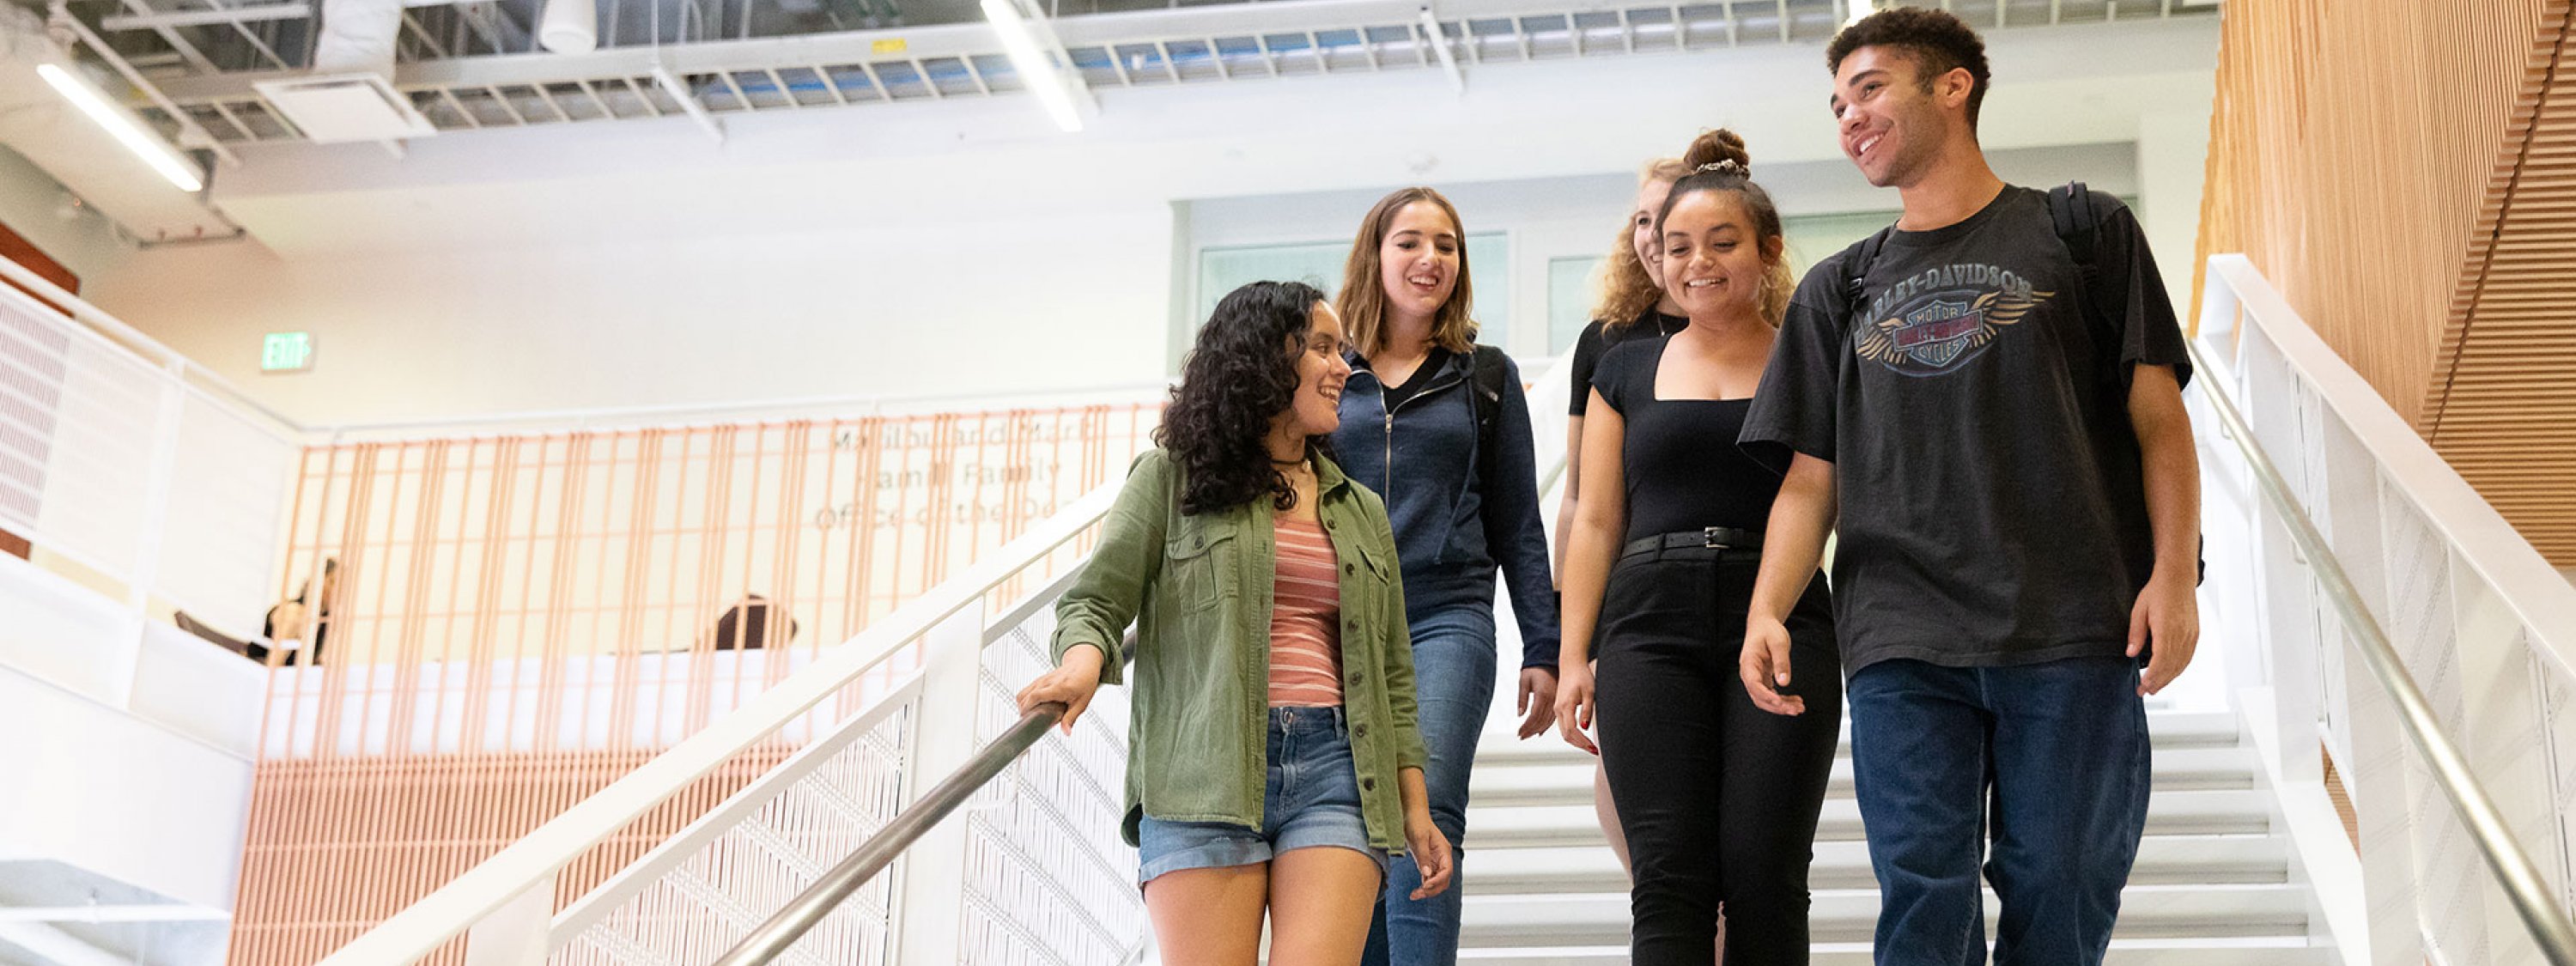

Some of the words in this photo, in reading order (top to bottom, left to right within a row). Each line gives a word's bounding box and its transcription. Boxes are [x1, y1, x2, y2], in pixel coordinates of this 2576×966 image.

[1916, 306, 1958, 325] MOTOR
[1917, 340, 1960, 362] CYCLES
[835, 422, 936, 450] Mailou
[956, 418, 1007, 444] and
[963, 457, 1060, 488] Family
[817, 503, 902, 531] Ofce
